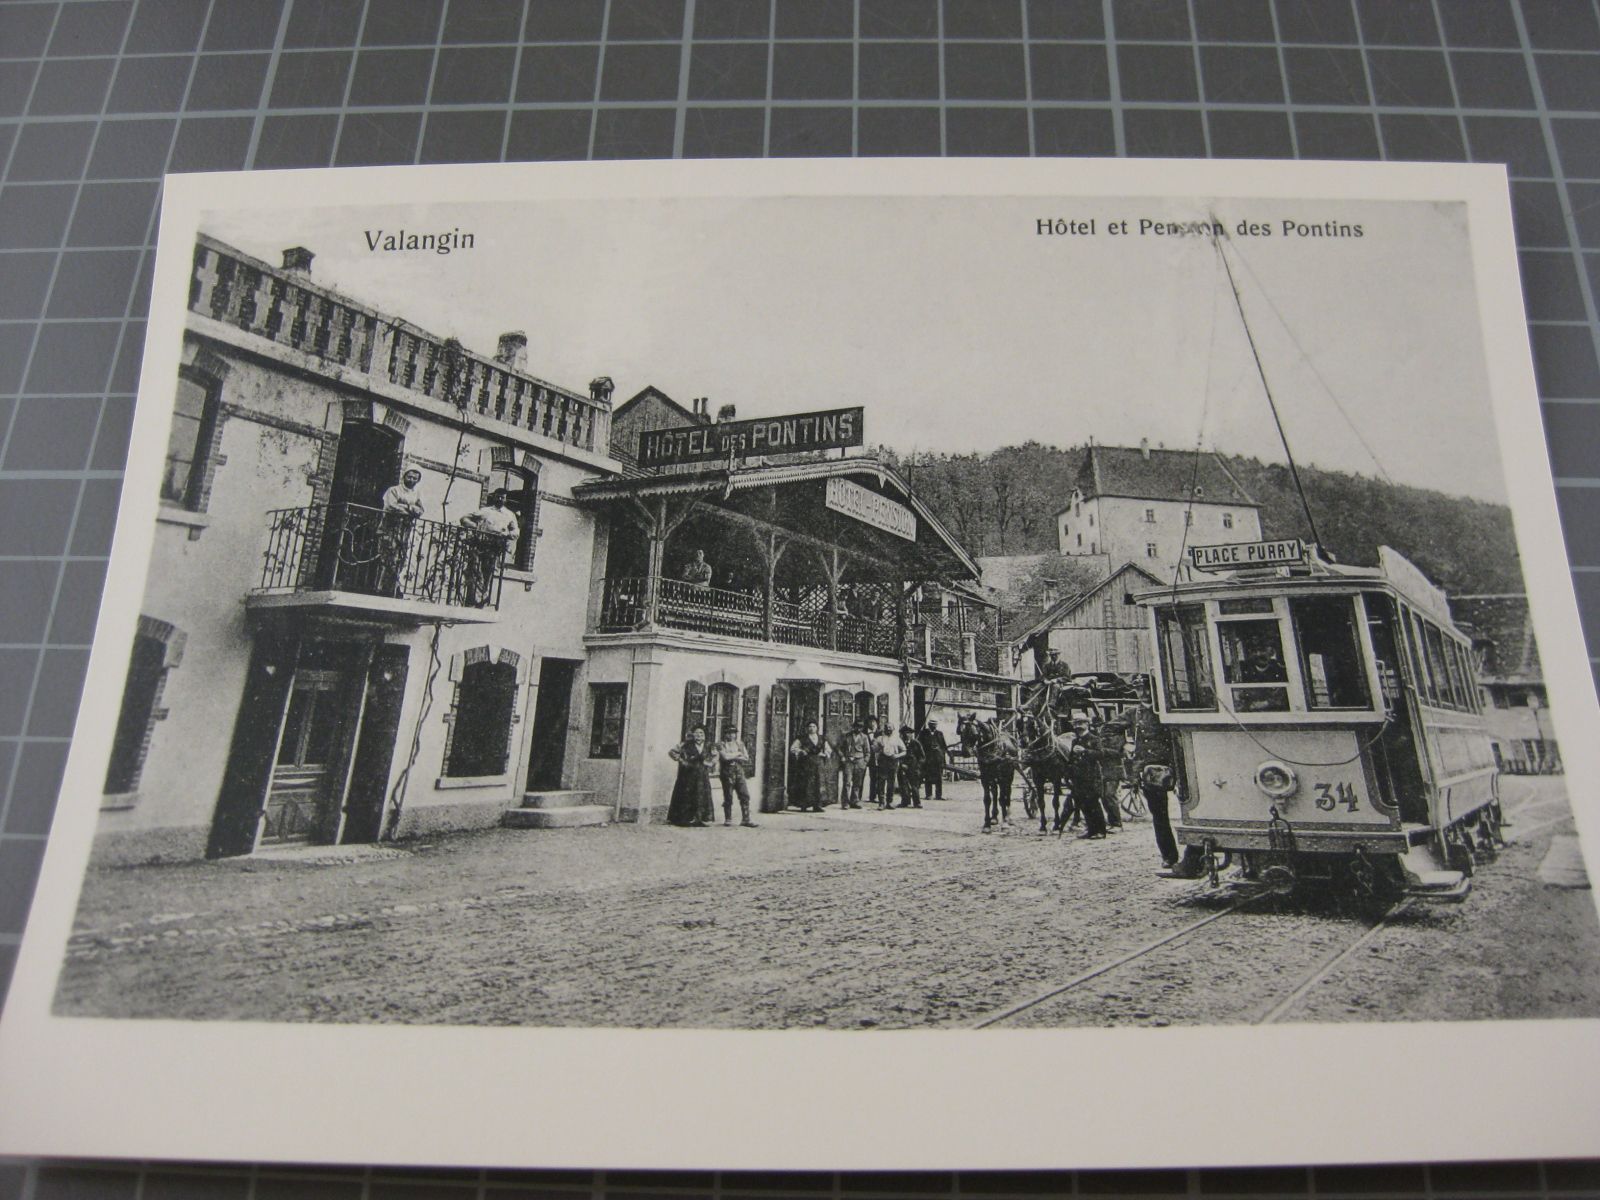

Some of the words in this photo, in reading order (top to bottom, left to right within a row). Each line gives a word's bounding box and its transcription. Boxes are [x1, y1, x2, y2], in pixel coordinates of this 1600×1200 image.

[364, 227, 475, 255] Valangin
[1036, 218, 1096, 236] Hôtel
[1108, 219, 1128, 236] et
[1139, 218, 1225, 236] Penon
[1236, 219, 1272, 237] des
[1282, 220, 1365, 238] Pontins
[721, 433, 747, 452] DES
[752, 413, 854, 449] PONTINS
[1196, 547, 1239, 564] PLACE
[1314, 781, 1360, 813] 34
